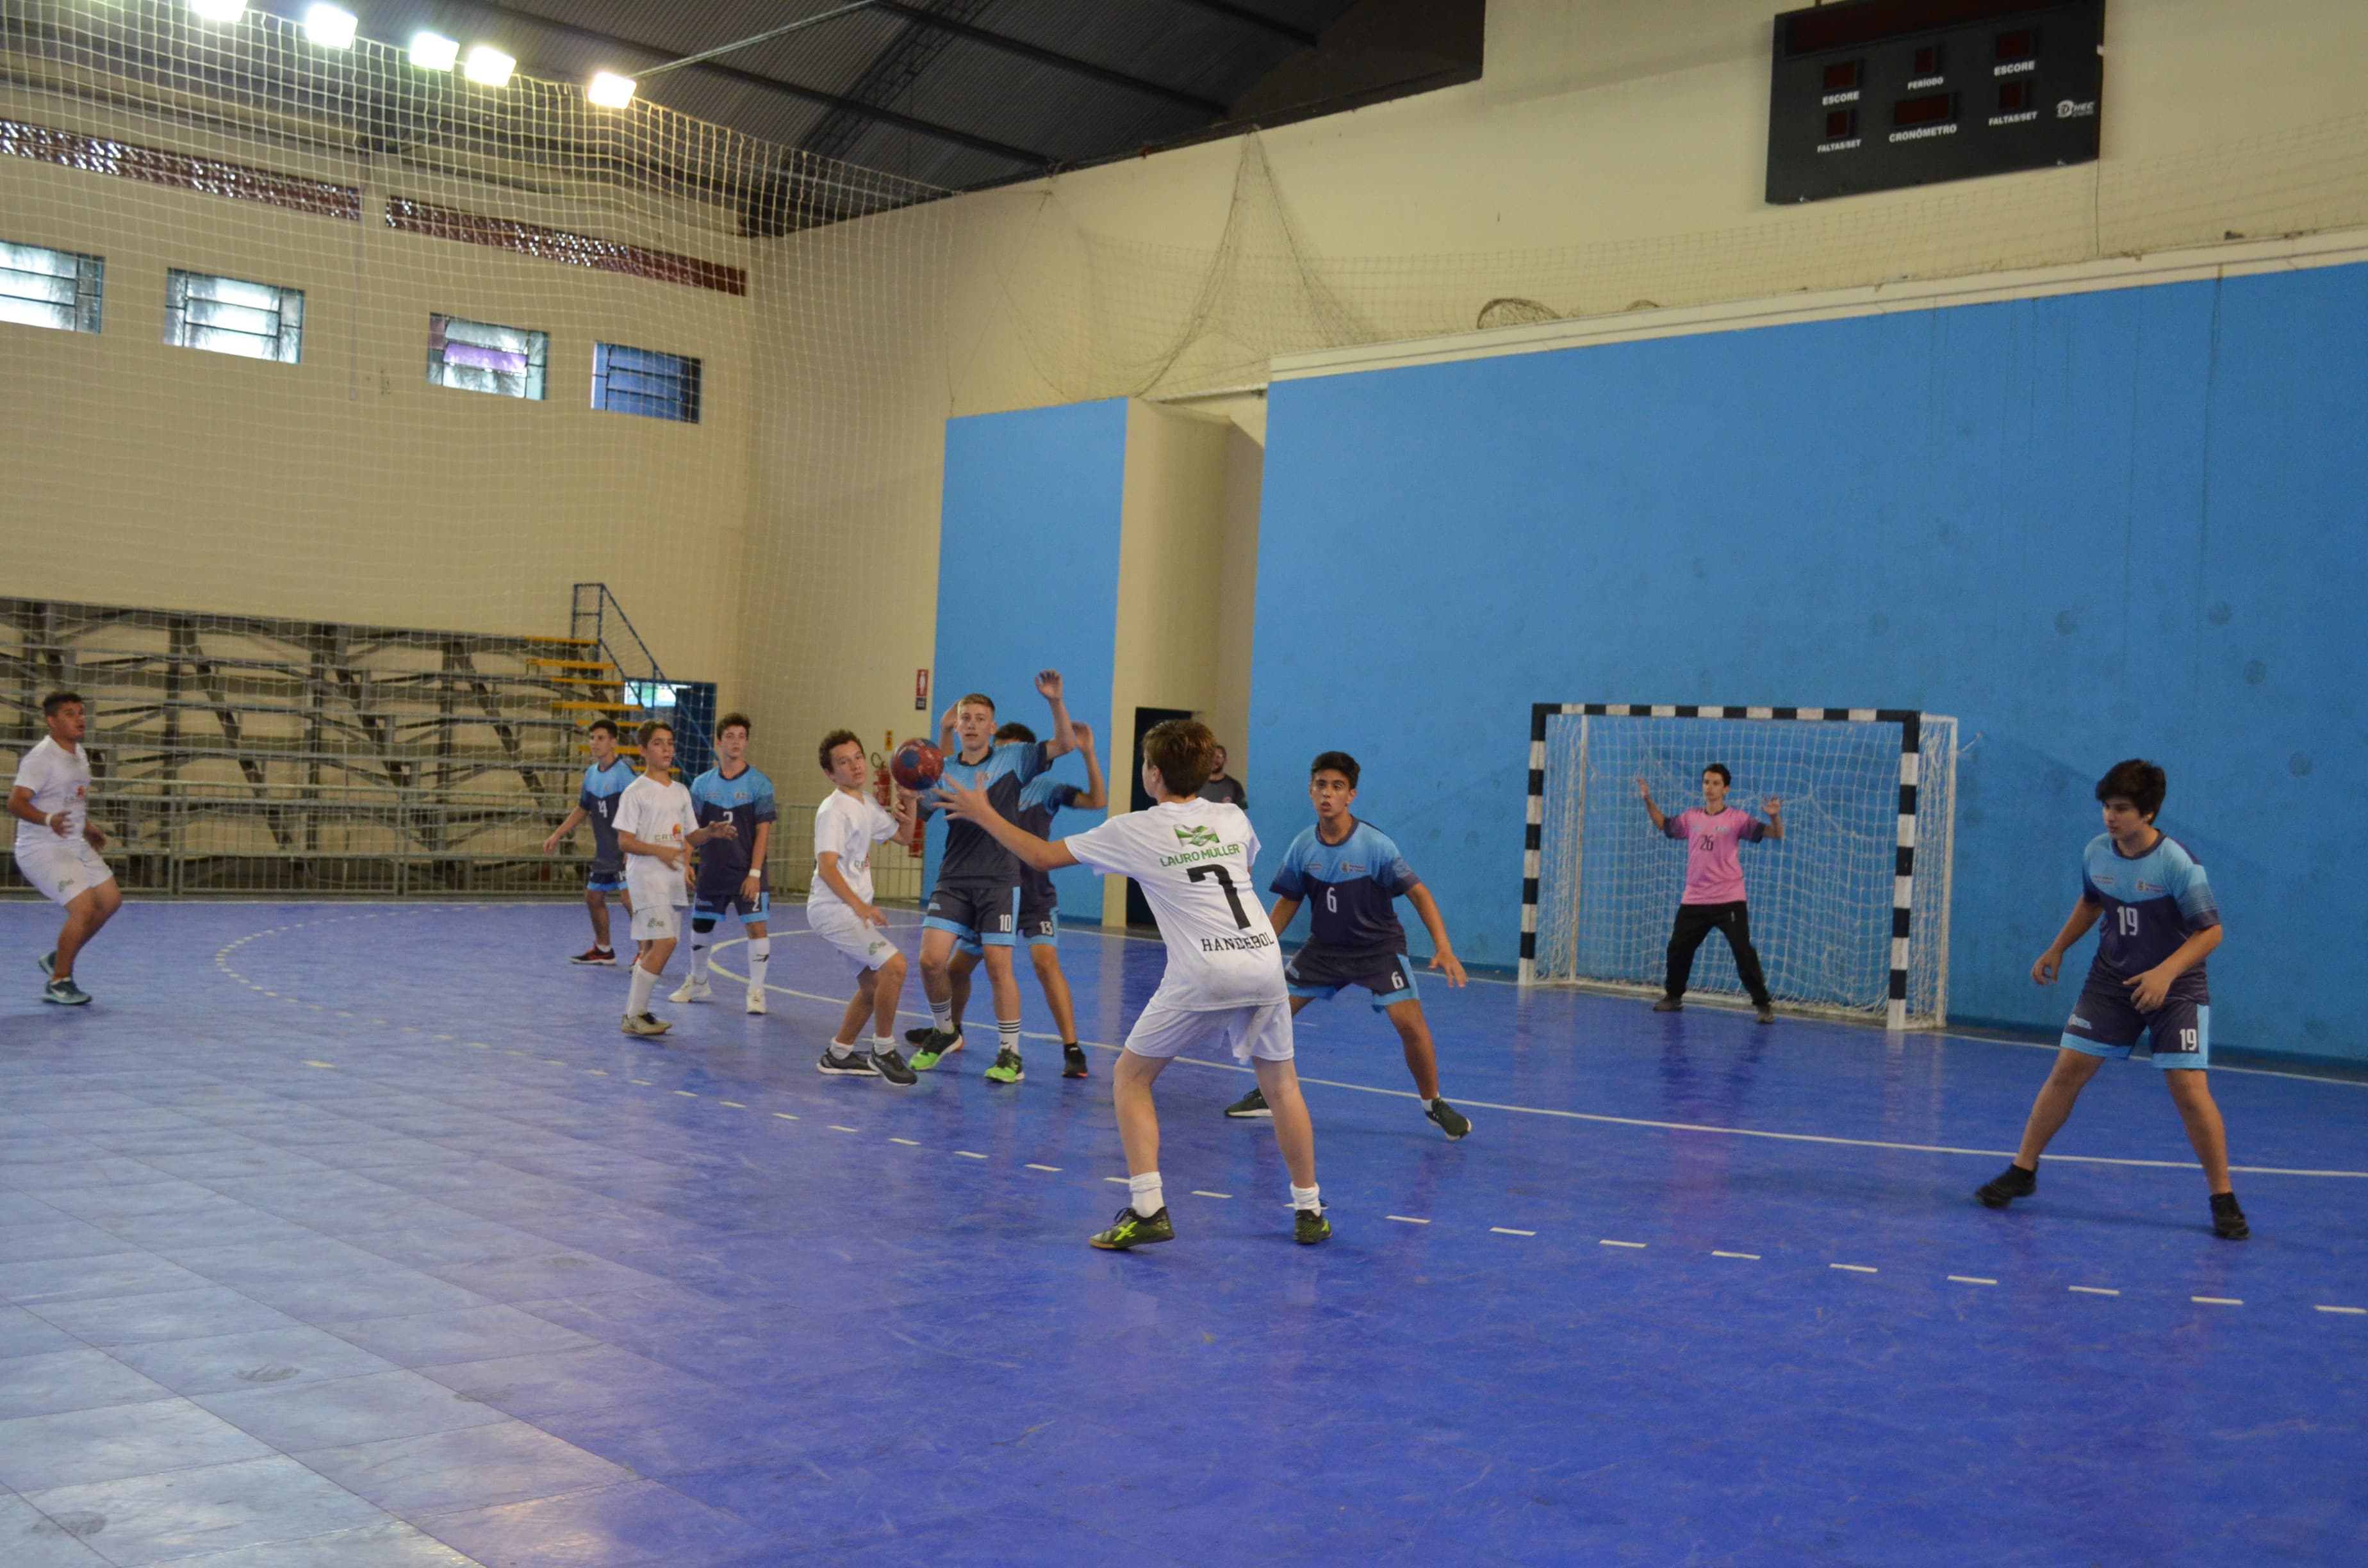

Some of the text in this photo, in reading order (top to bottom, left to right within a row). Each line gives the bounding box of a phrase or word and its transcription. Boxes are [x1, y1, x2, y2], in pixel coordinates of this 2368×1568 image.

[1993, 60, 2035, 77] ESCORE
[1907, 76, 1944, 90] PERÍODO
[1822, 91, 1860, 106] ESCORE
[1988, 111, 2038, 127] FALTAS/SET
[1889, 124, 1957, 143] CRONÔMETRO
[1817, 138, 1862, 153] FALTAS/SET
[598, 800, 608, 818] 14
[1700, 835, 1714, 851] 26
[1160, 844, 1240, 867] LAURO MÜLLER
[1187, 863, 1251, 930] 7
[1326, 886, 1337, 913] 6
[999, 914, 1012, 932] 10
[1040, 920, 1054, 935] 13
[2117, 906, 2139, 936] 19
[1391, 971, 1404, 990] 6
[2180, 1028, 2198, 1051] 19
